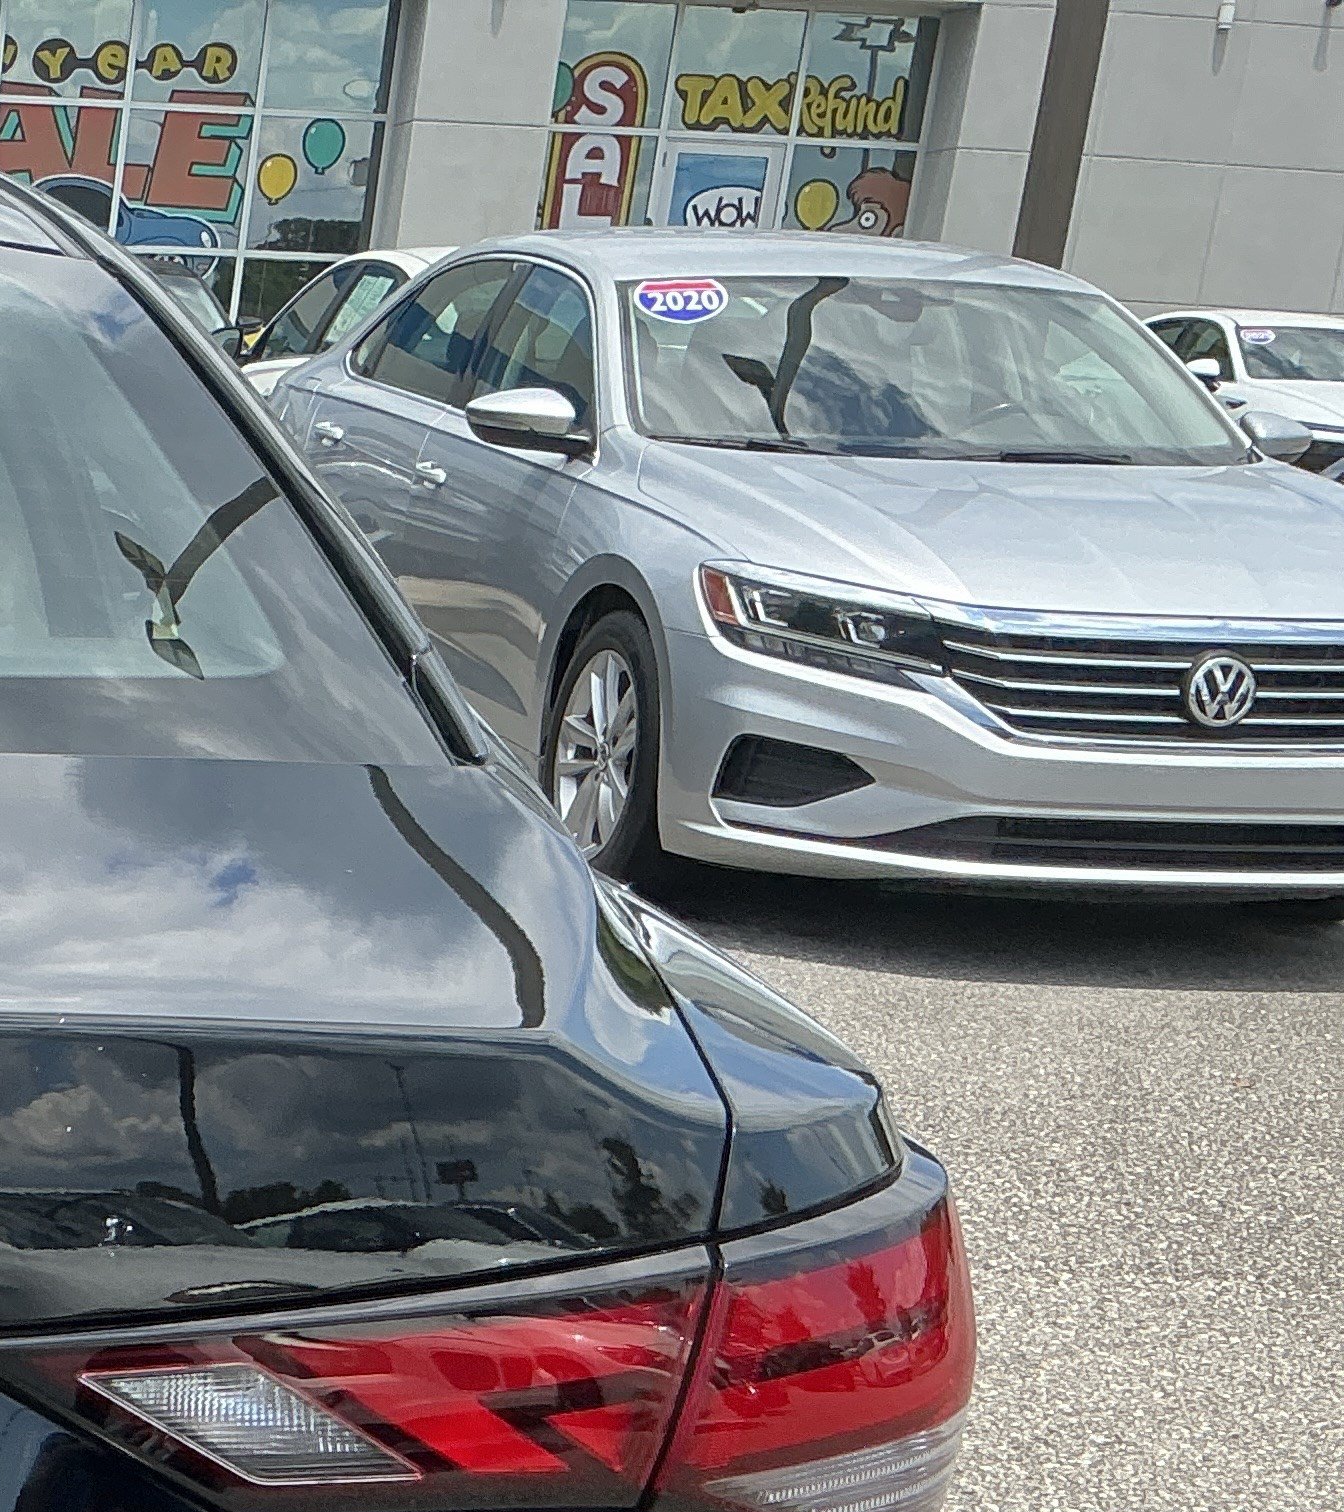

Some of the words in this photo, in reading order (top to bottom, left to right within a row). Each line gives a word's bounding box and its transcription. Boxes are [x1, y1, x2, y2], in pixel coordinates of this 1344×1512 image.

[675, 74, 791, 131] TAX
[790, 74, 907, 154] Refund
[692, 195, 760, 228] WOW
[647, 290, 720, 311] 2020
